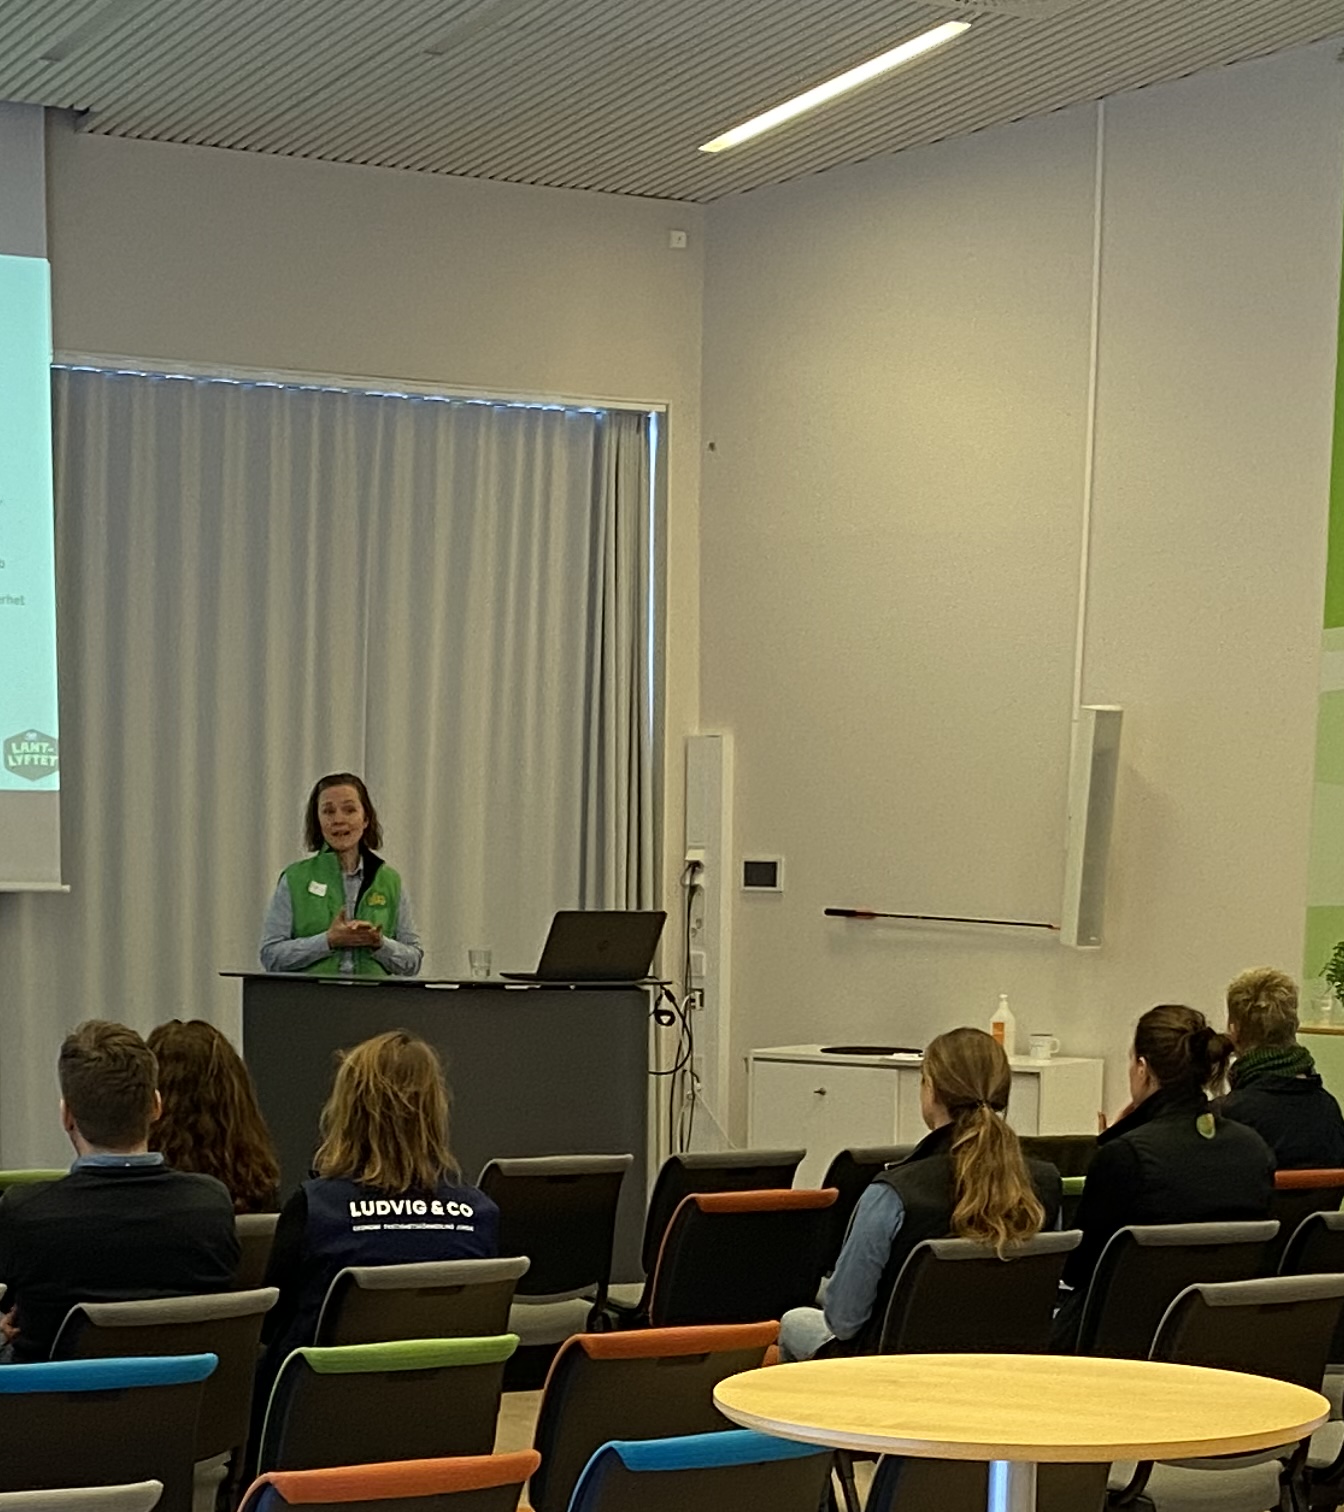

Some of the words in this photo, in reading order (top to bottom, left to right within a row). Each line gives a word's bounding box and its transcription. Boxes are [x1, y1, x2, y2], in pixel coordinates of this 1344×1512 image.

[349, 1200, 427, 1217] LUDVIG
[431, 1200, 445, 1216] &
[446, 1201, 474, 1217] CO
